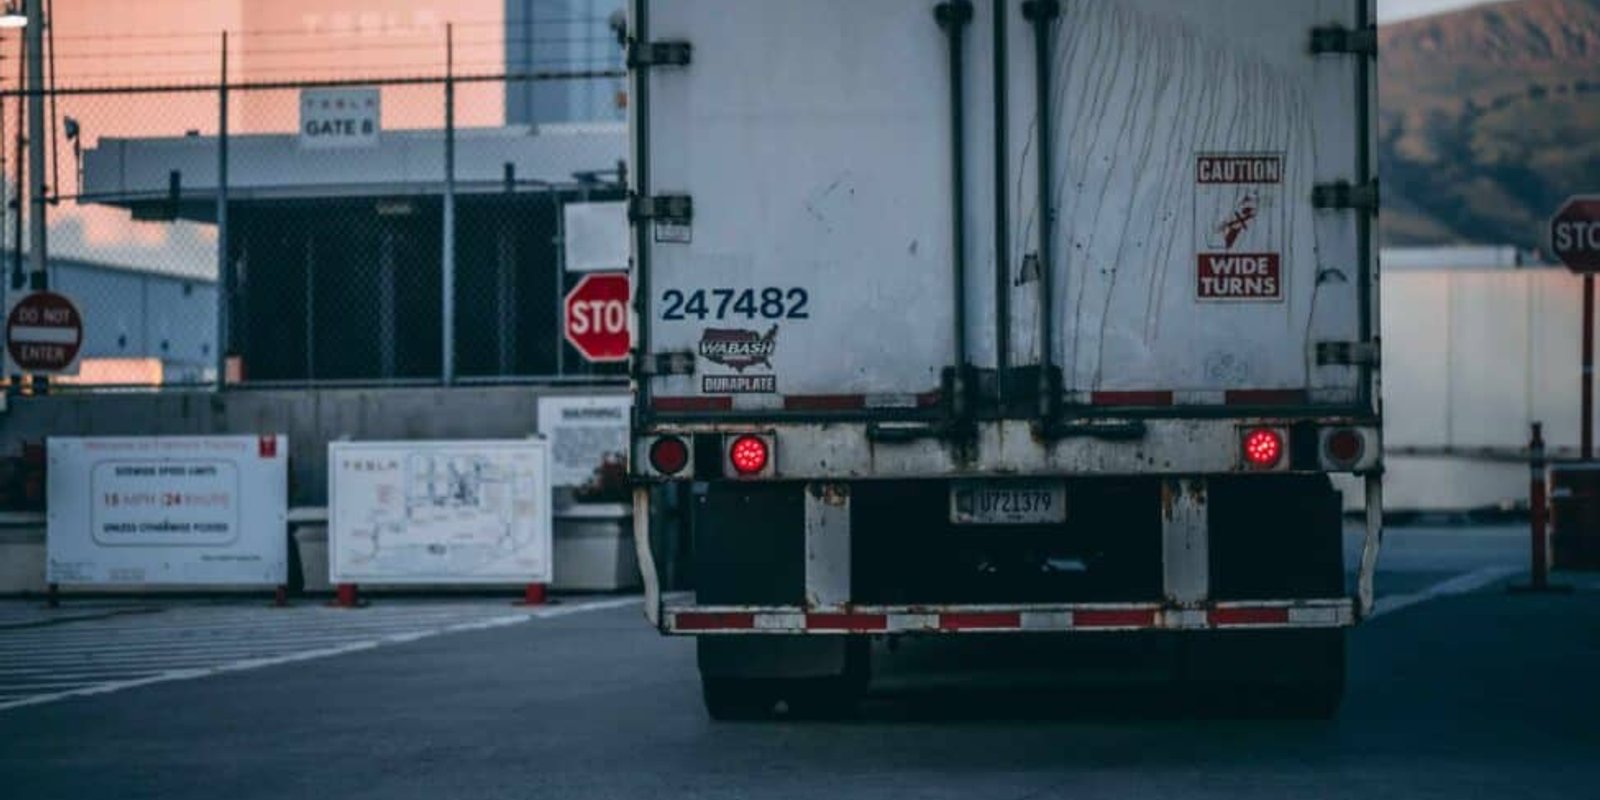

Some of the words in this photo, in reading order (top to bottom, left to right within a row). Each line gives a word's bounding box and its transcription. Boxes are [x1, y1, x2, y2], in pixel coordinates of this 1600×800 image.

[305, 118, 356, 136] GATE
[1199, 159, 1278, 182] CAUTION
[1556, 221, 1600, 251] STO
[1210, 256, 1269, 275] WIDE
[1200, 276, 1276, 295] TURNS
[661, 286, 809, 321] 247482
[19, 307, 38, 323] DO
[43, 307, 70, 324] NOT
[570, 300, 629, 334] STO
[21, 344, 65, 361] ENTER
[701, 340, 774, 355] WABASH
[704, 377, 774, 391] DURAPLATE
